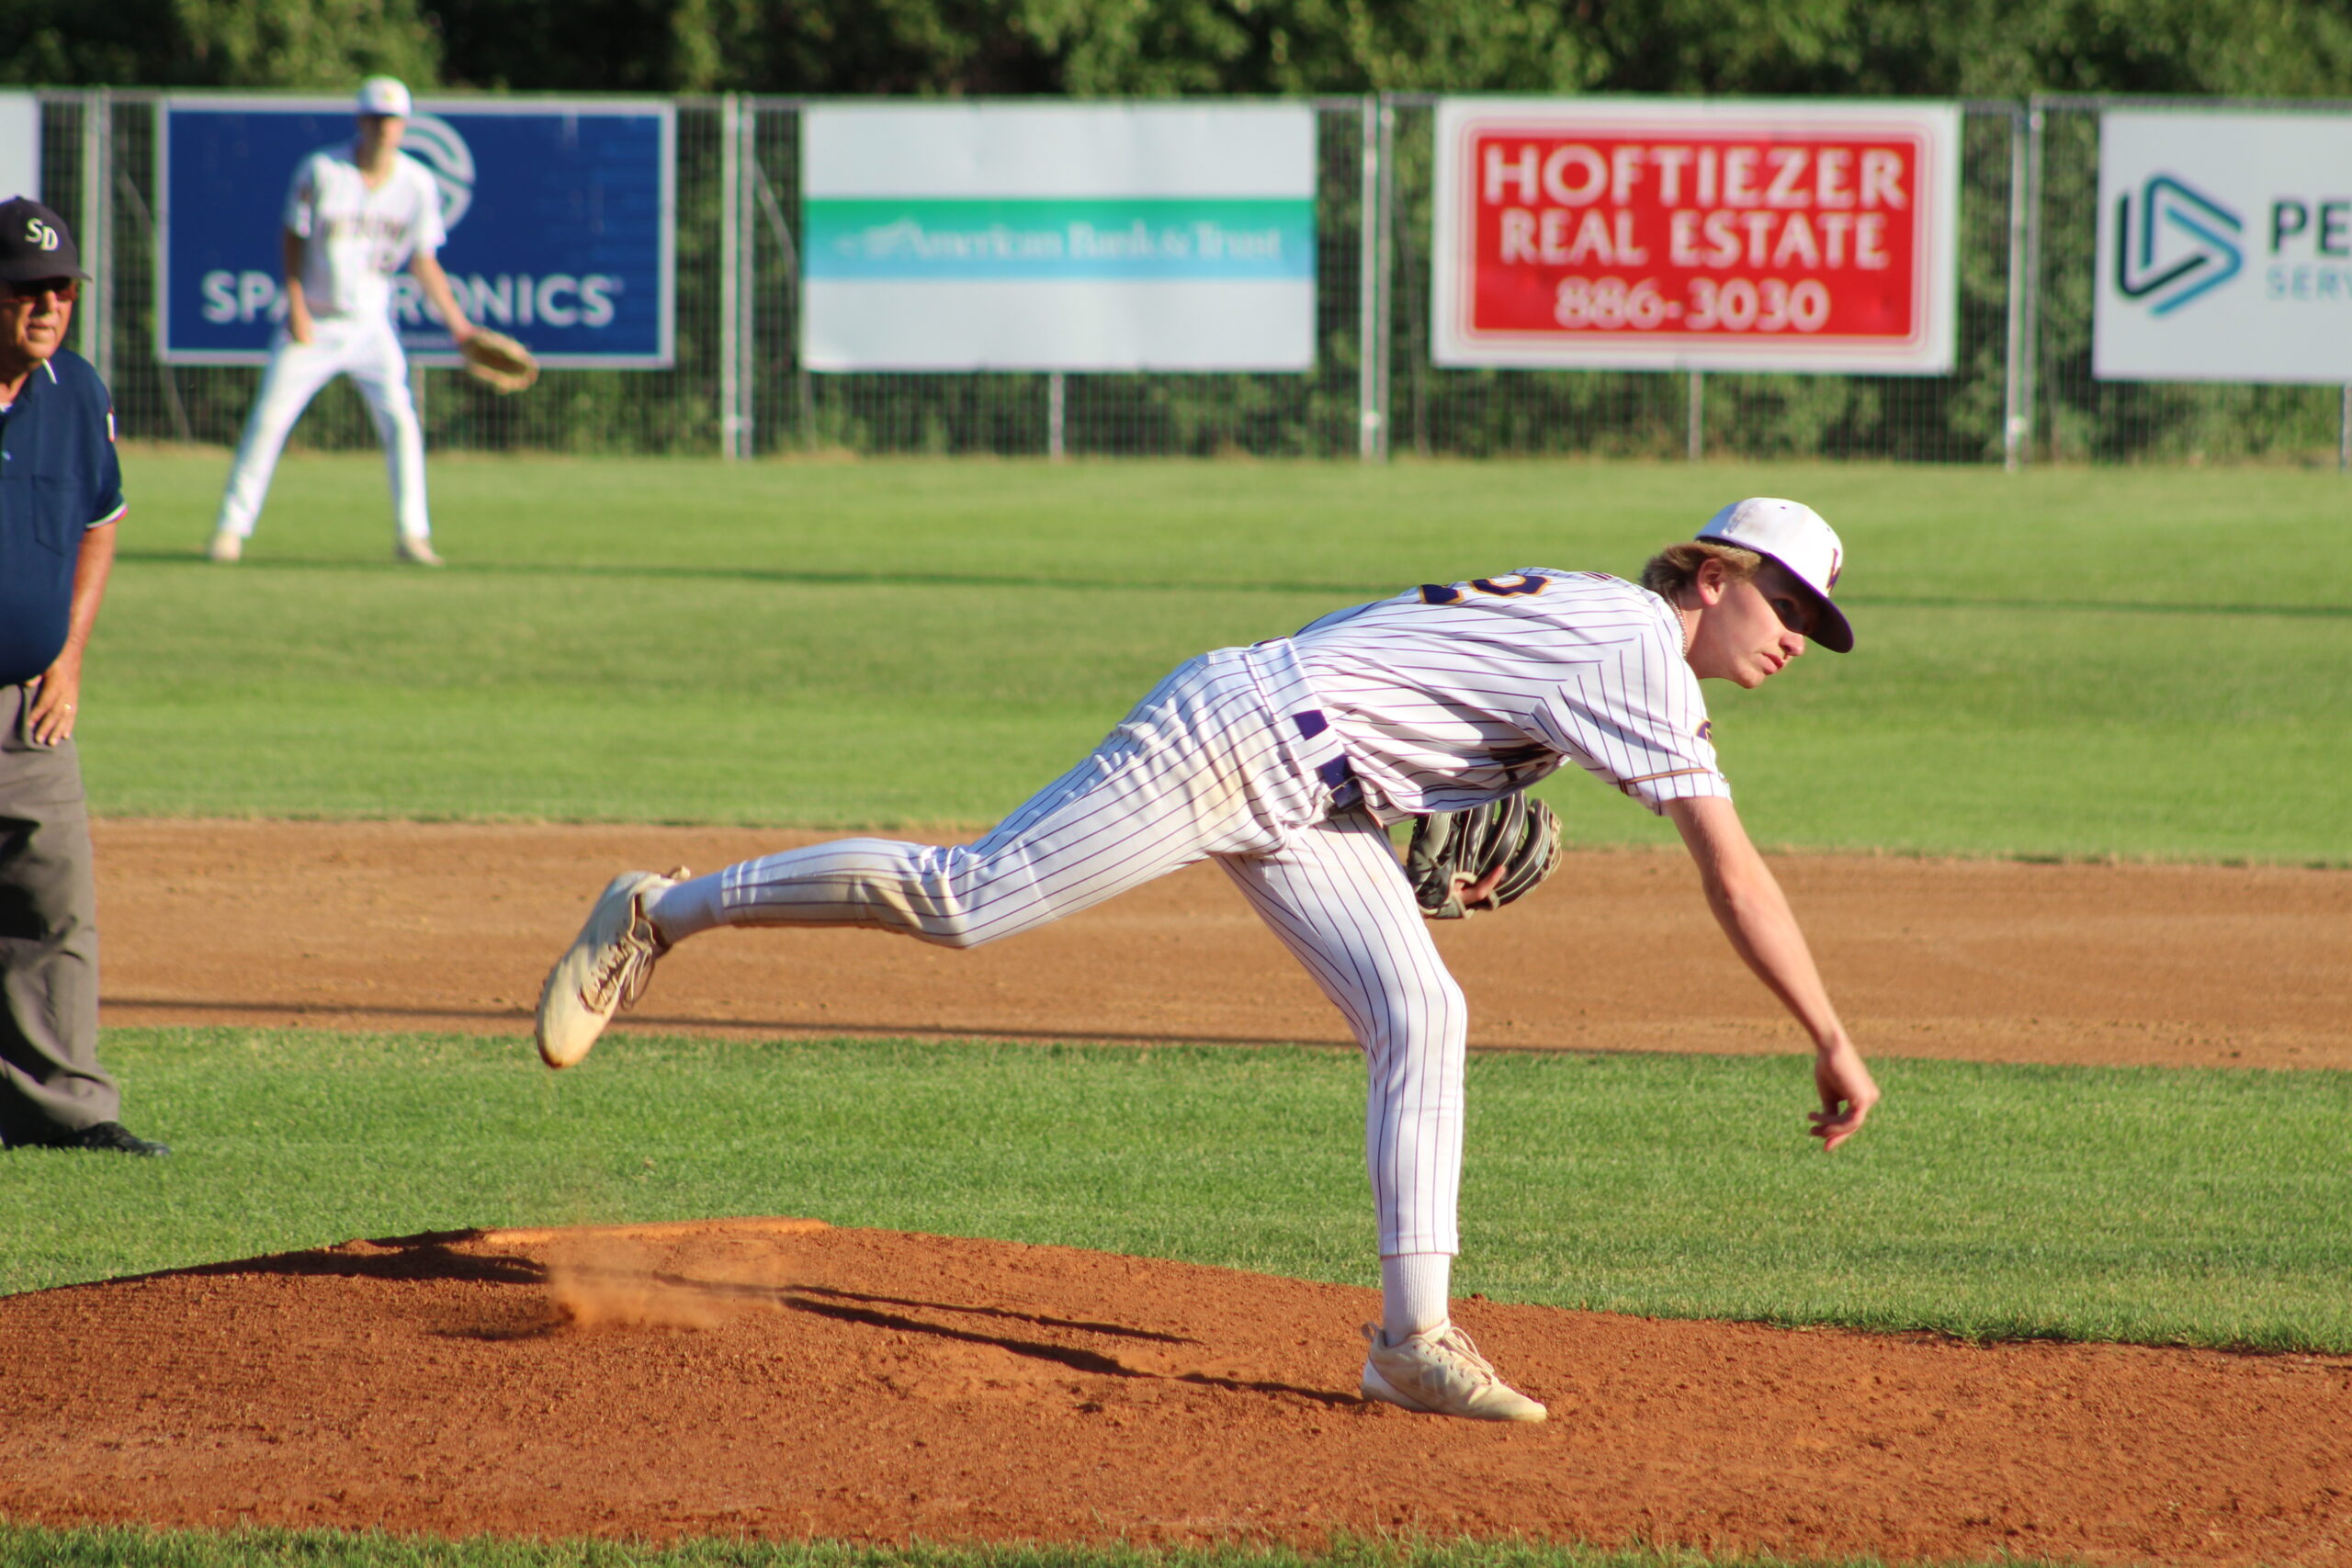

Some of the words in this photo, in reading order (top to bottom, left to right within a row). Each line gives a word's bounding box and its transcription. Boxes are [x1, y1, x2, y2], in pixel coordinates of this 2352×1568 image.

[1484, 143, 1907, 210] HOFTIEZER
[25, 218, 59, 251] SD
[888, 219, 1062, 260] American
[1067, 218, 1156, 261] Bank
[1193, 221, 1282, 261] Trust
[1500, 208, 1649, 265] REAL
[1669, 209, 1891, 269] ESTATE
[201, 271, 616, 327] SPRONICS
[1554, 275, 1831, 333] 886-3030
